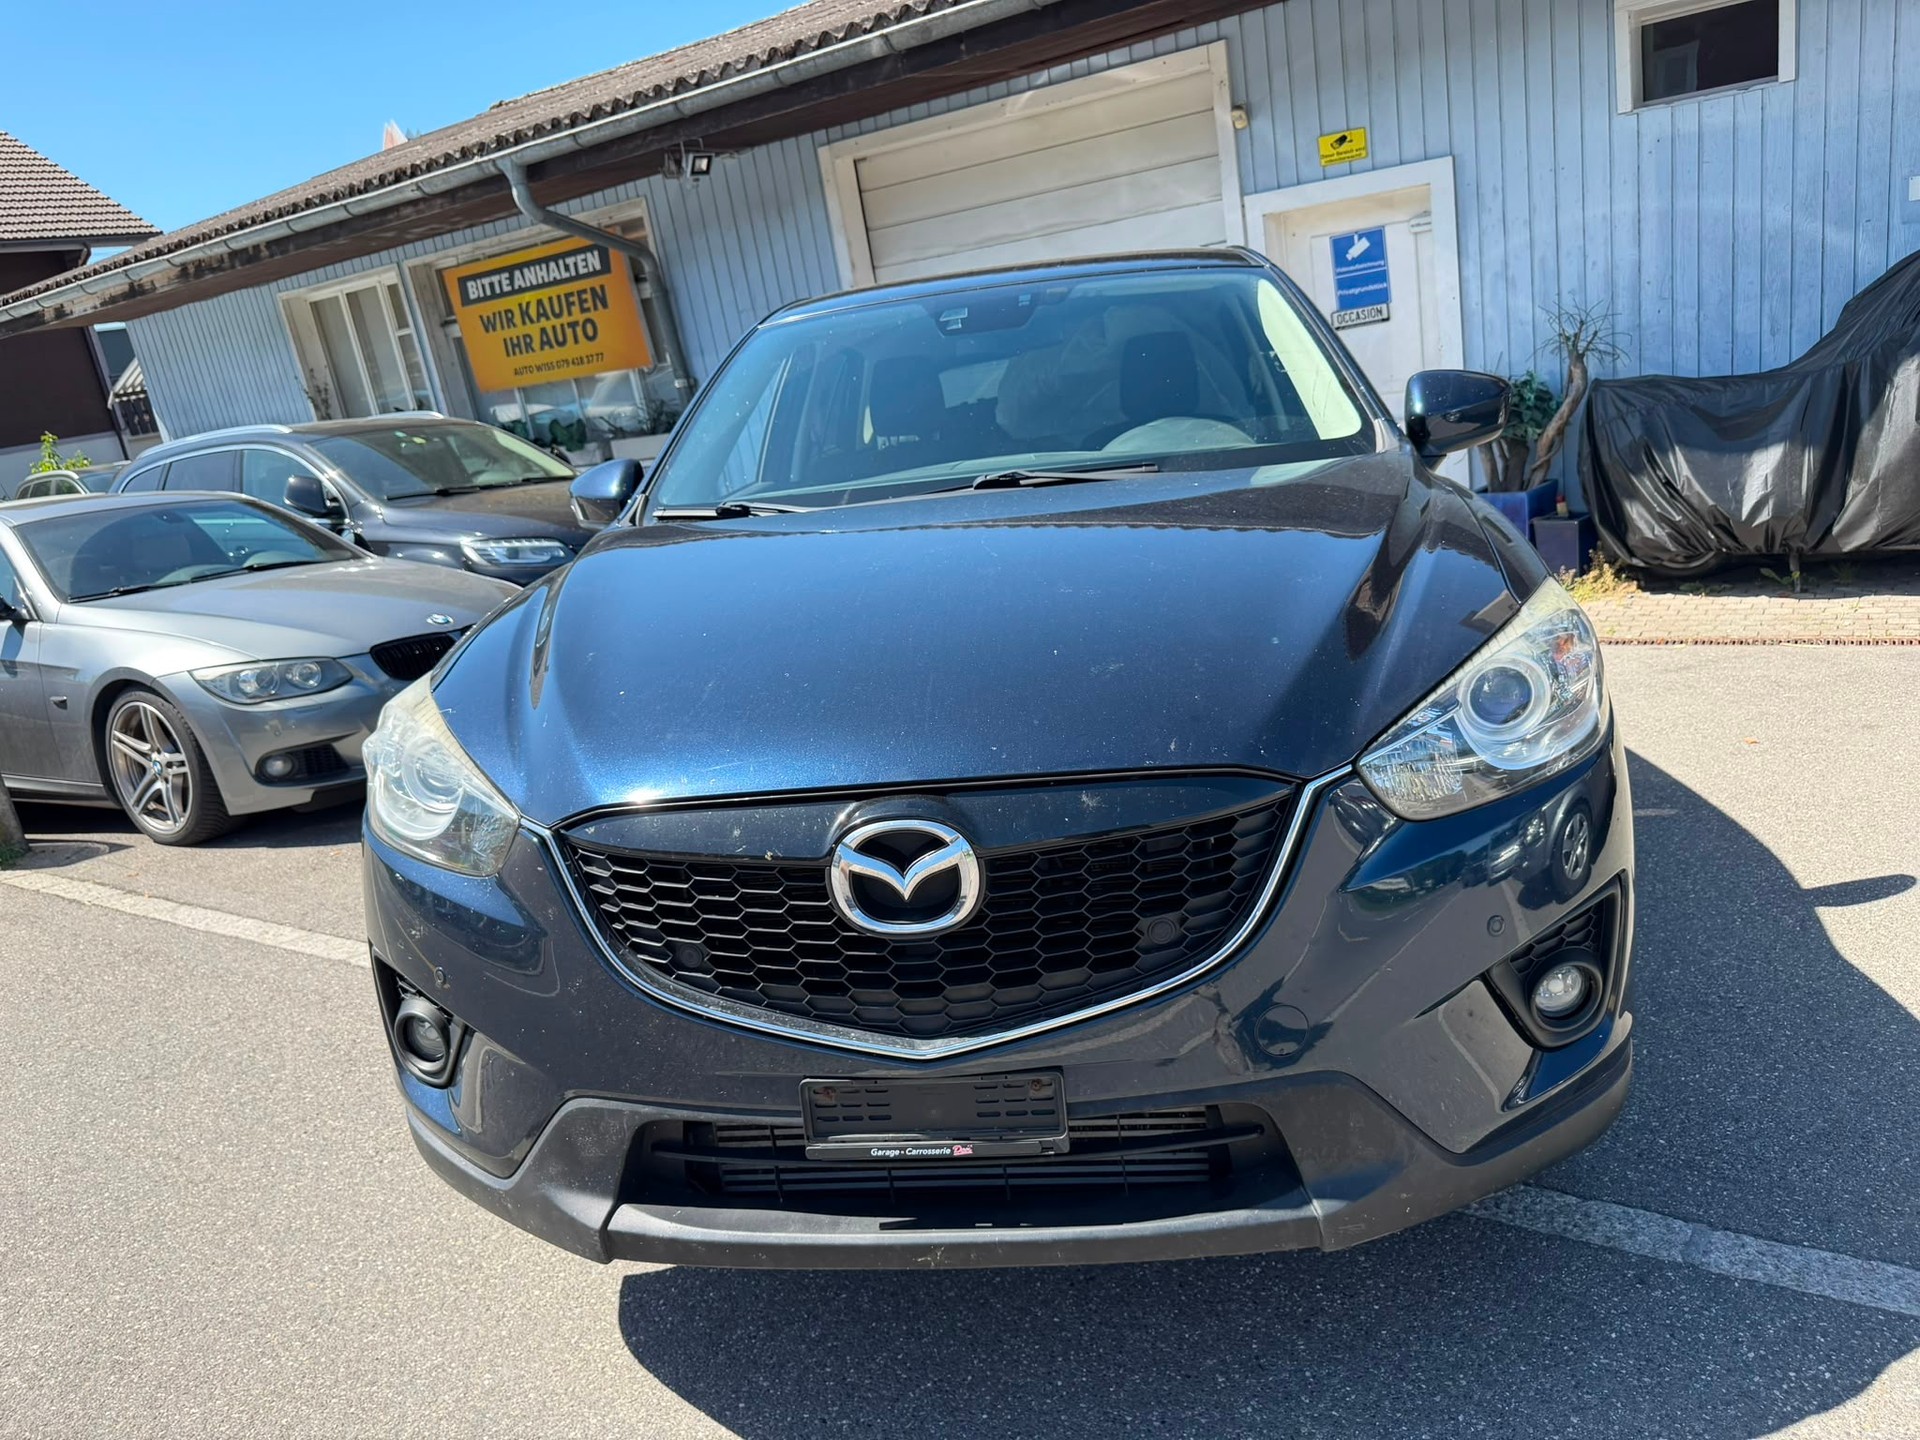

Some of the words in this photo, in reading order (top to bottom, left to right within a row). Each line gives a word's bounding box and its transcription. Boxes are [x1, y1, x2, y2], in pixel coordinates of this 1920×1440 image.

[466, 274, 512, 300] BITTE
[514, 250, 601, 289] ANHALTEN
[479, 309, 517, 334] WIR
[518, 284, 609, 327] KAUFEN
[1336, 306, 1383, 325] OCCASION
[503, 332, 536, 358] IHR
[539, 318, 599, 351] AUTO
[514, 364, 534, 376] AUTO
[534, 361, 556, 373] WISS
[556, 359, 570, 370] 079
[870, 1148, 900, 1158] Garage
[905, 1146, 951, 1156] Carrosserie
